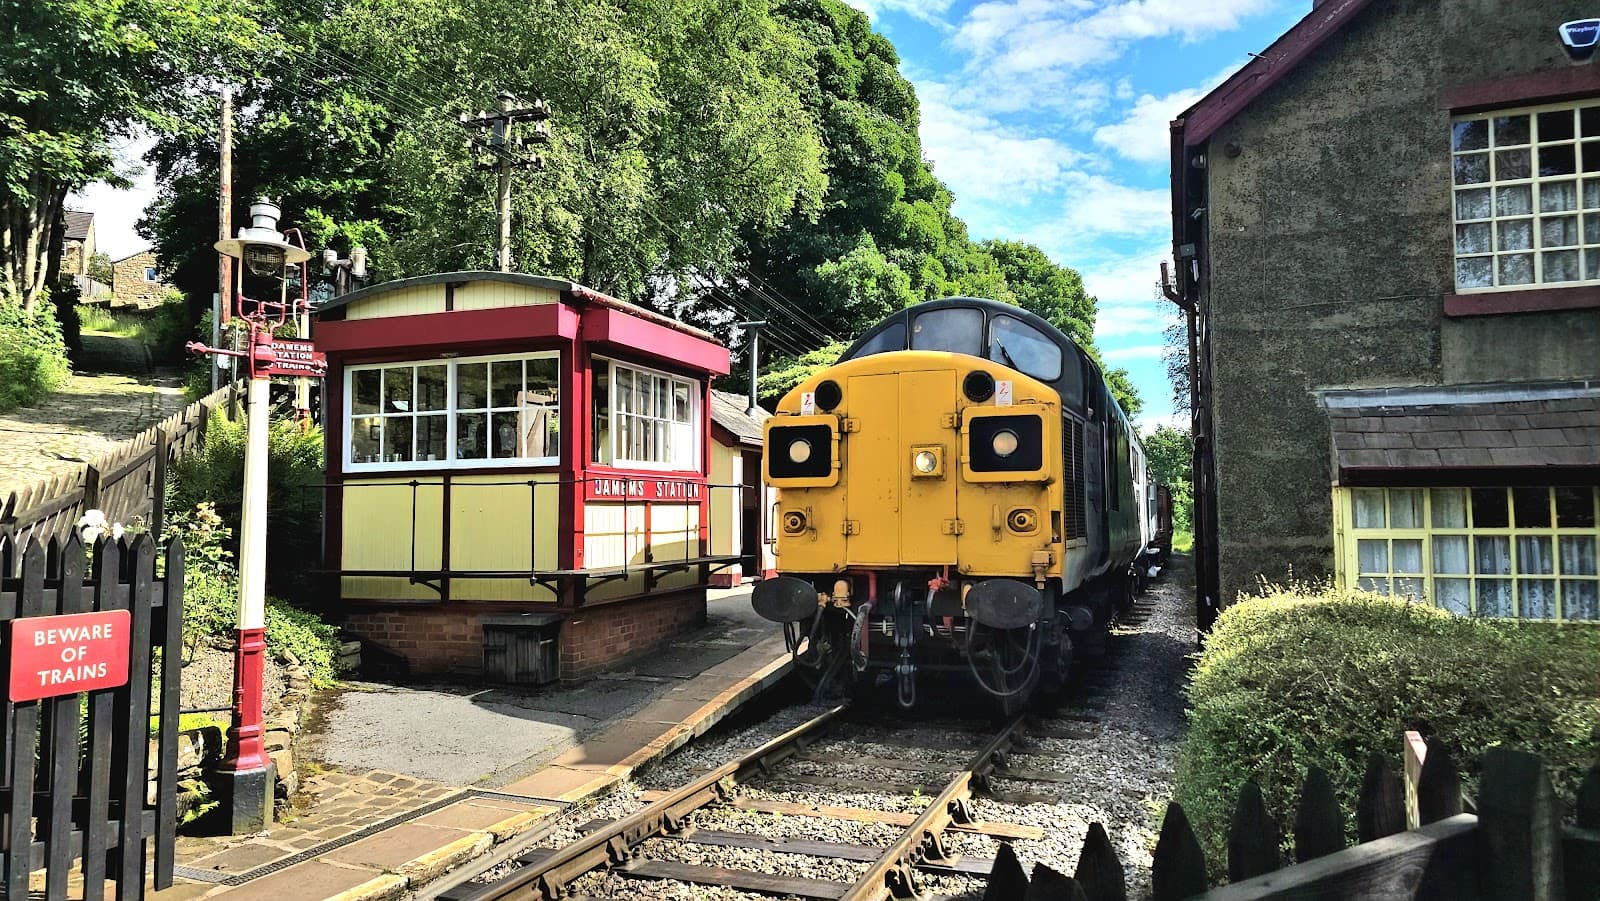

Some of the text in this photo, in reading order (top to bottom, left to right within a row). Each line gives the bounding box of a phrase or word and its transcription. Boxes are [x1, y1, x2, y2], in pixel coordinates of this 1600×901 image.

[656, 482, 699, 498] STATION
[33, 623, 113, 647] BEWARE
[61, 646, 87, 663] OF
[37, 662, 107, 687] TRAINS
